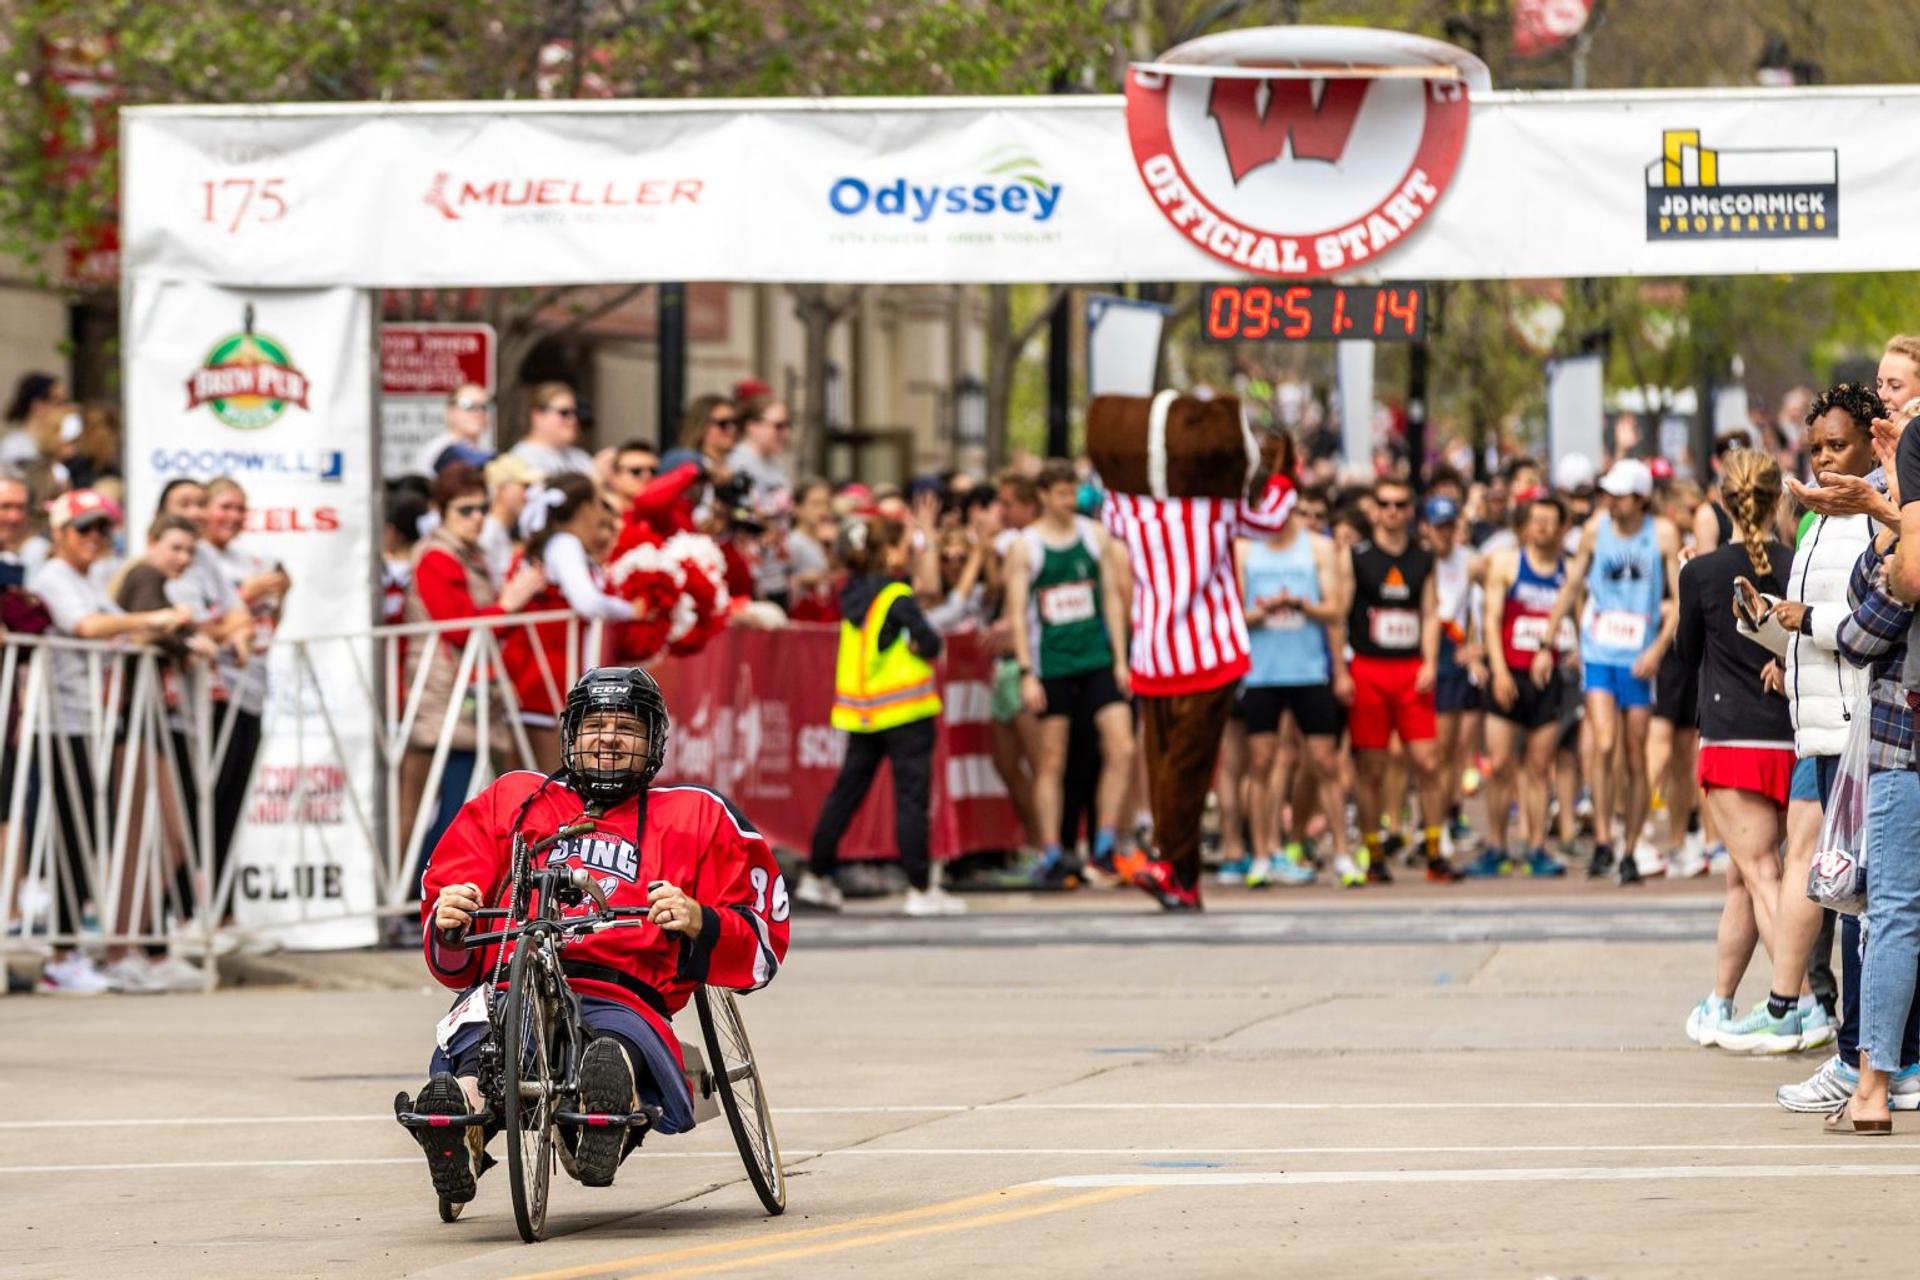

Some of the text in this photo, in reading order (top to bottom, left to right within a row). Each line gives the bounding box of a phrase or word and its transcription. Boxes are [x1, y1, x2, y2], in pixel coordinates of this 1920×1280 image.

[201, 177, 288, 235] 175
[459, 178, 706, 206] MUELLER
[829, 177, 1063, 222] Odyssey
[1142, 153, 1438, 273] OFFICIAL START
[1659, 213, 1826, 233] PROPERTIES
[153, 449, 312, 473] GOODWILL
[592, 686, 629, 694] CCM
[242, 865, 343, 899] CLUB
